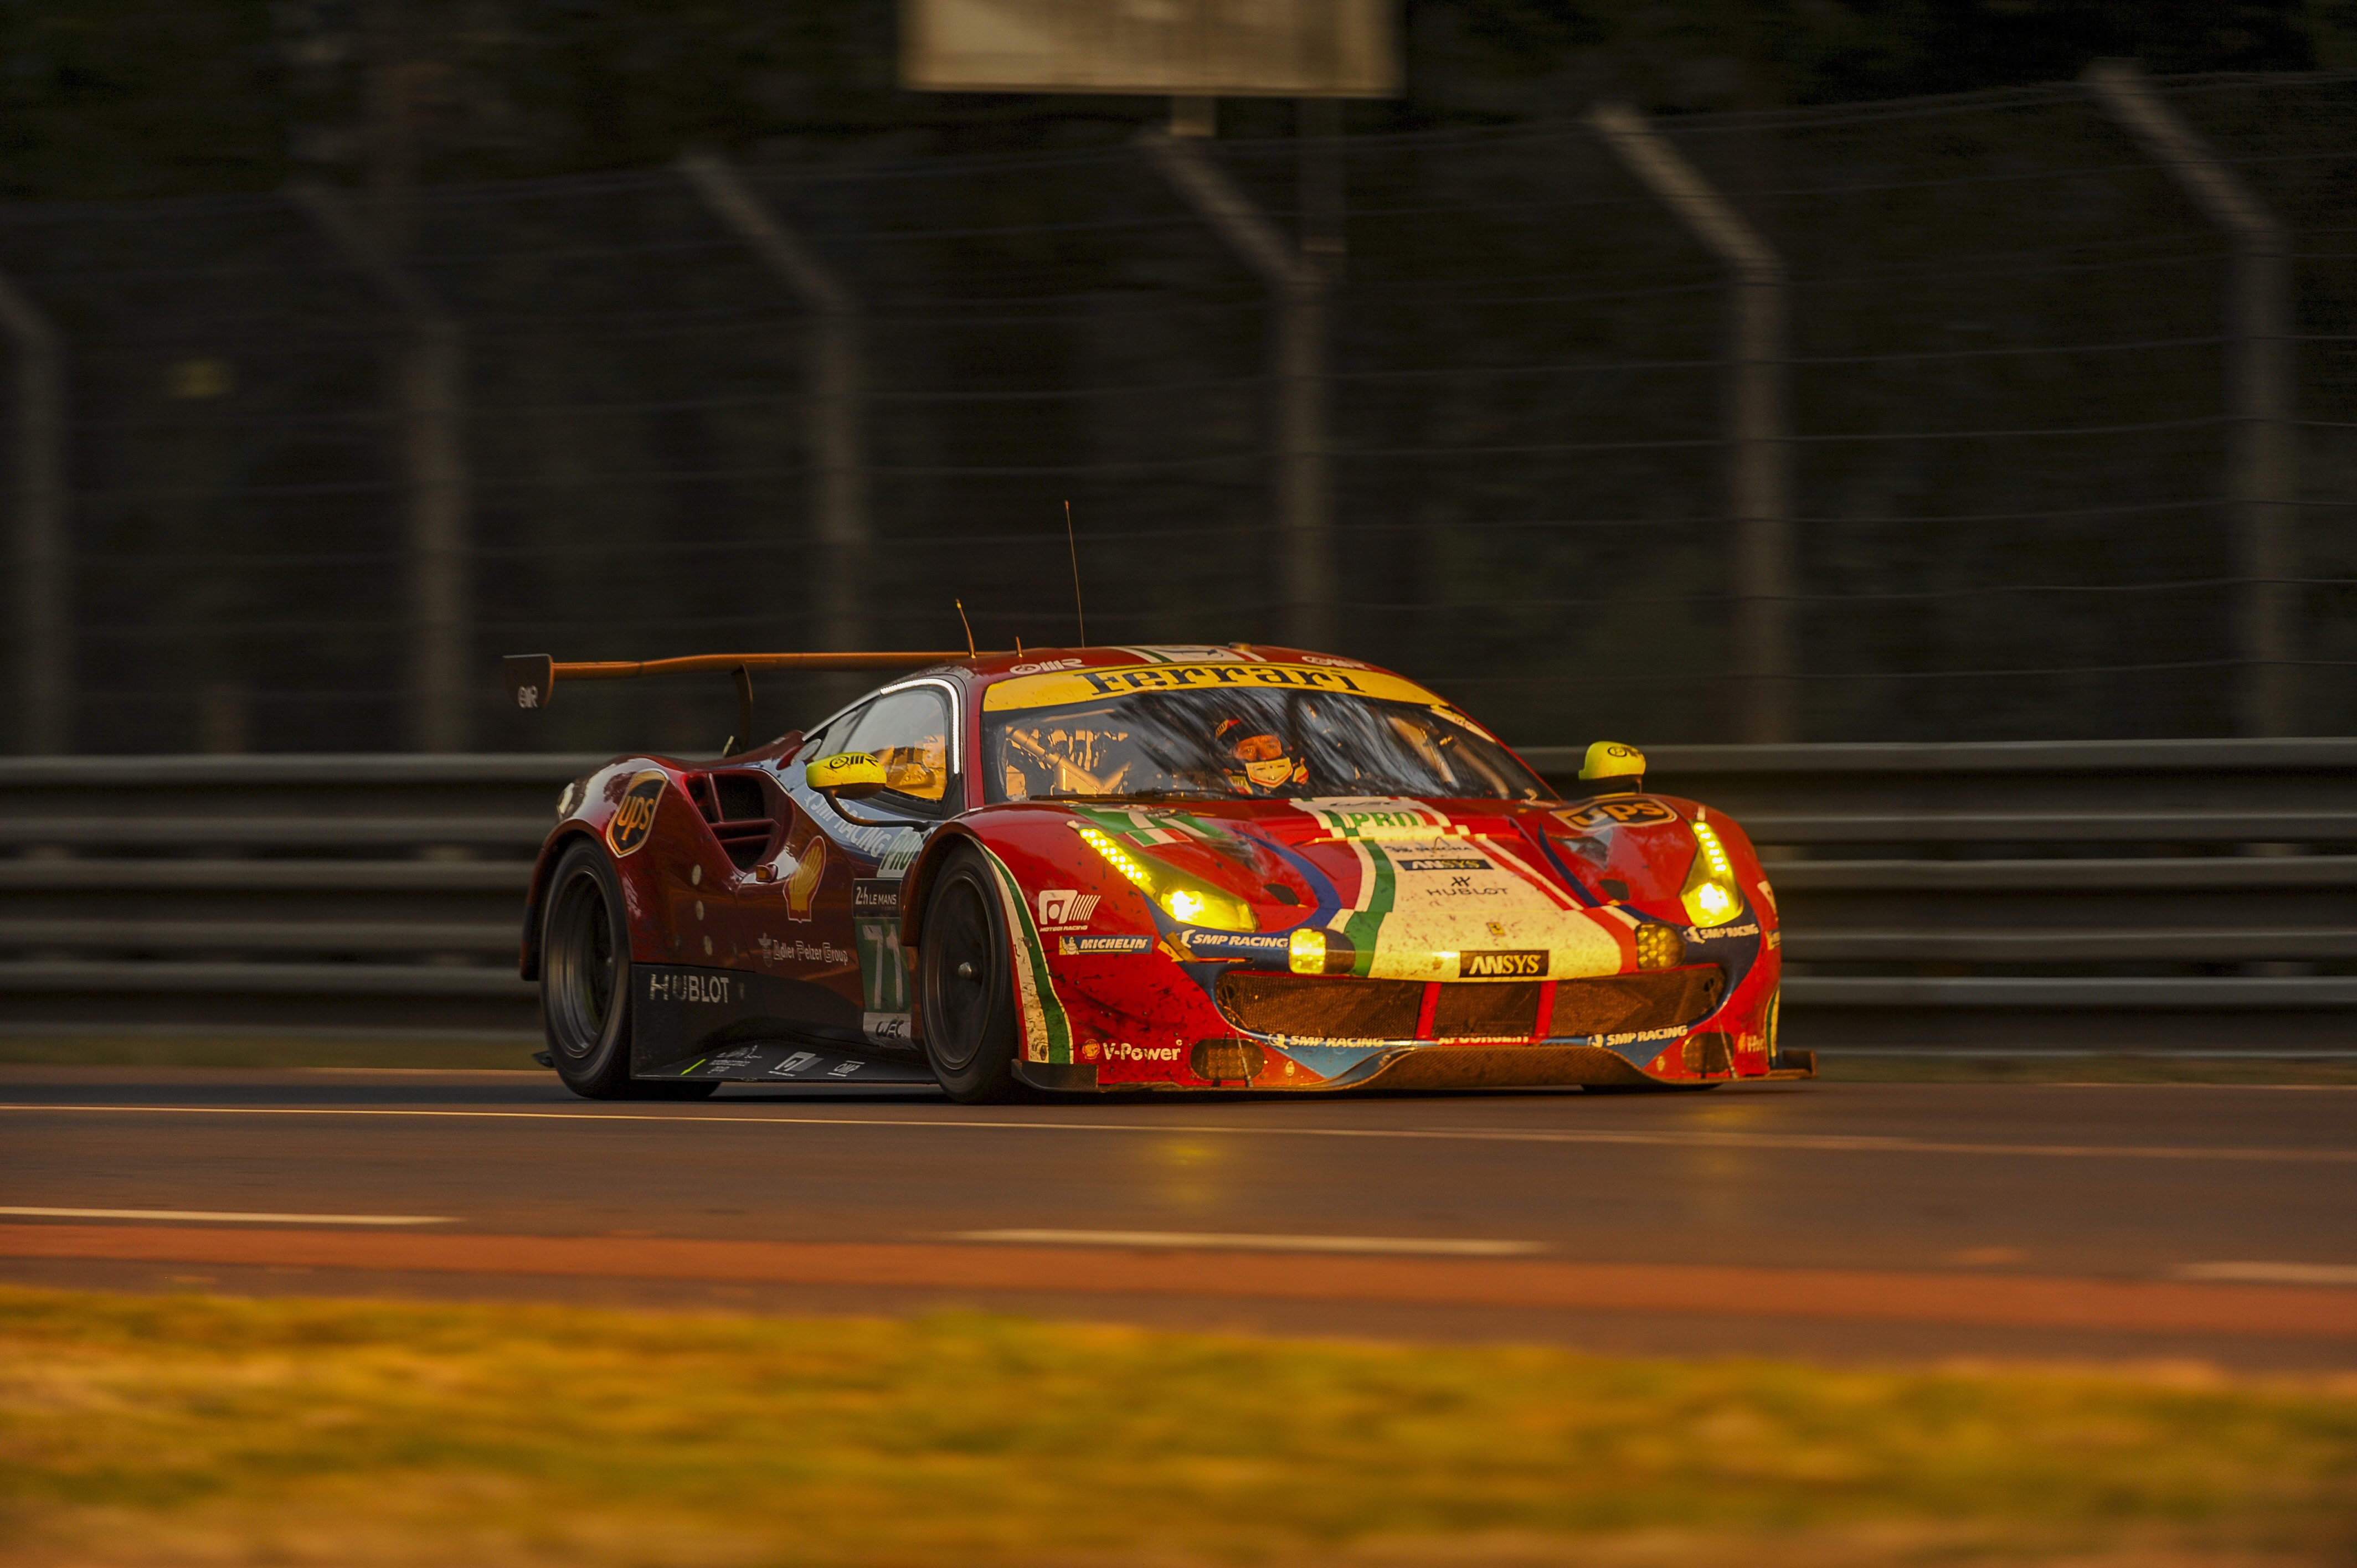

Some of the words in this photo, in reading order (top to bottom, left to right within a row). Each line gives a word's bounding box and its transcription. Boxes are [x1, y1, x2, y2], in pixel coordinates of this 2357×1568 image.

[1074, 666, 1366, 696] Ferrari
[617, 795, 655, 840] ups
[1347, 812, 1418, 827] PRO
[1571, 803, 1664, 826] ups
[1412, 860, 1480, 869] ANSYS
[869, 894, 877, 905] LE
[878, 894, 897, 905] MANS
[1427, 888, 1509, 896] HUBLOT
[1080, 938, 1148, 949] MICHELIN
[1192, 933, 1228, 945] SMP
[1228, 936, 1289, 948] RACING
[773, 940, 795, 961] Adler
[795, 940, 822, 961] Pelzer
[822, 942, 848, 966] Group
[862, 924, 903, 1010] 71
[1469, 955, 1541, 974] ANSYS
[650, 973, 729, 1003] HUBLOT
[1289, 1035, 1324, 1046] SMP
[1325, 1038, 1385, 1048] RACING
[1606, 1033, 1637, 1046] SMP
[1638, 1025, 1688, 1043] RACING
[1103, 1043, 1181, 1061] V-Power
